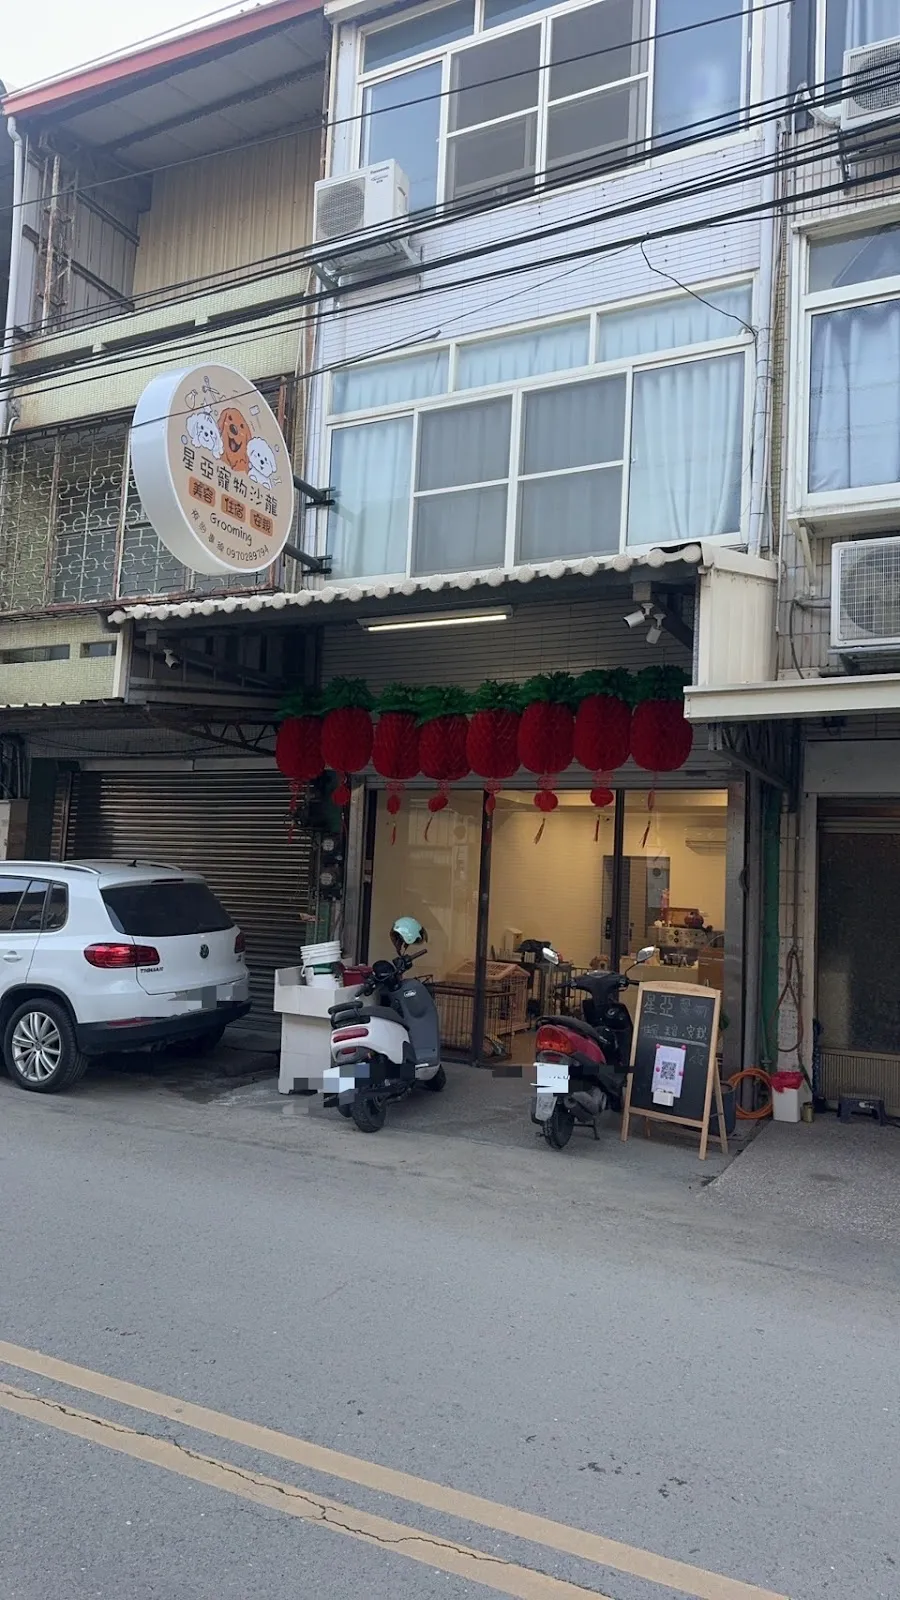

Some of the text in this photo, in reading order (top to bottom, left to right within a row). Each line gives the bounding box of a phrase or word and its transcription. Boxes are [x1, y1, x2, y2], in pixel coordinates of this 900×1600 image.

[182, 447, 278, 517] 星亞寵物沙龍
[192, 480, 272, 534] 美容 住宿 安親
[210, 512, 253, 547] Grooming
